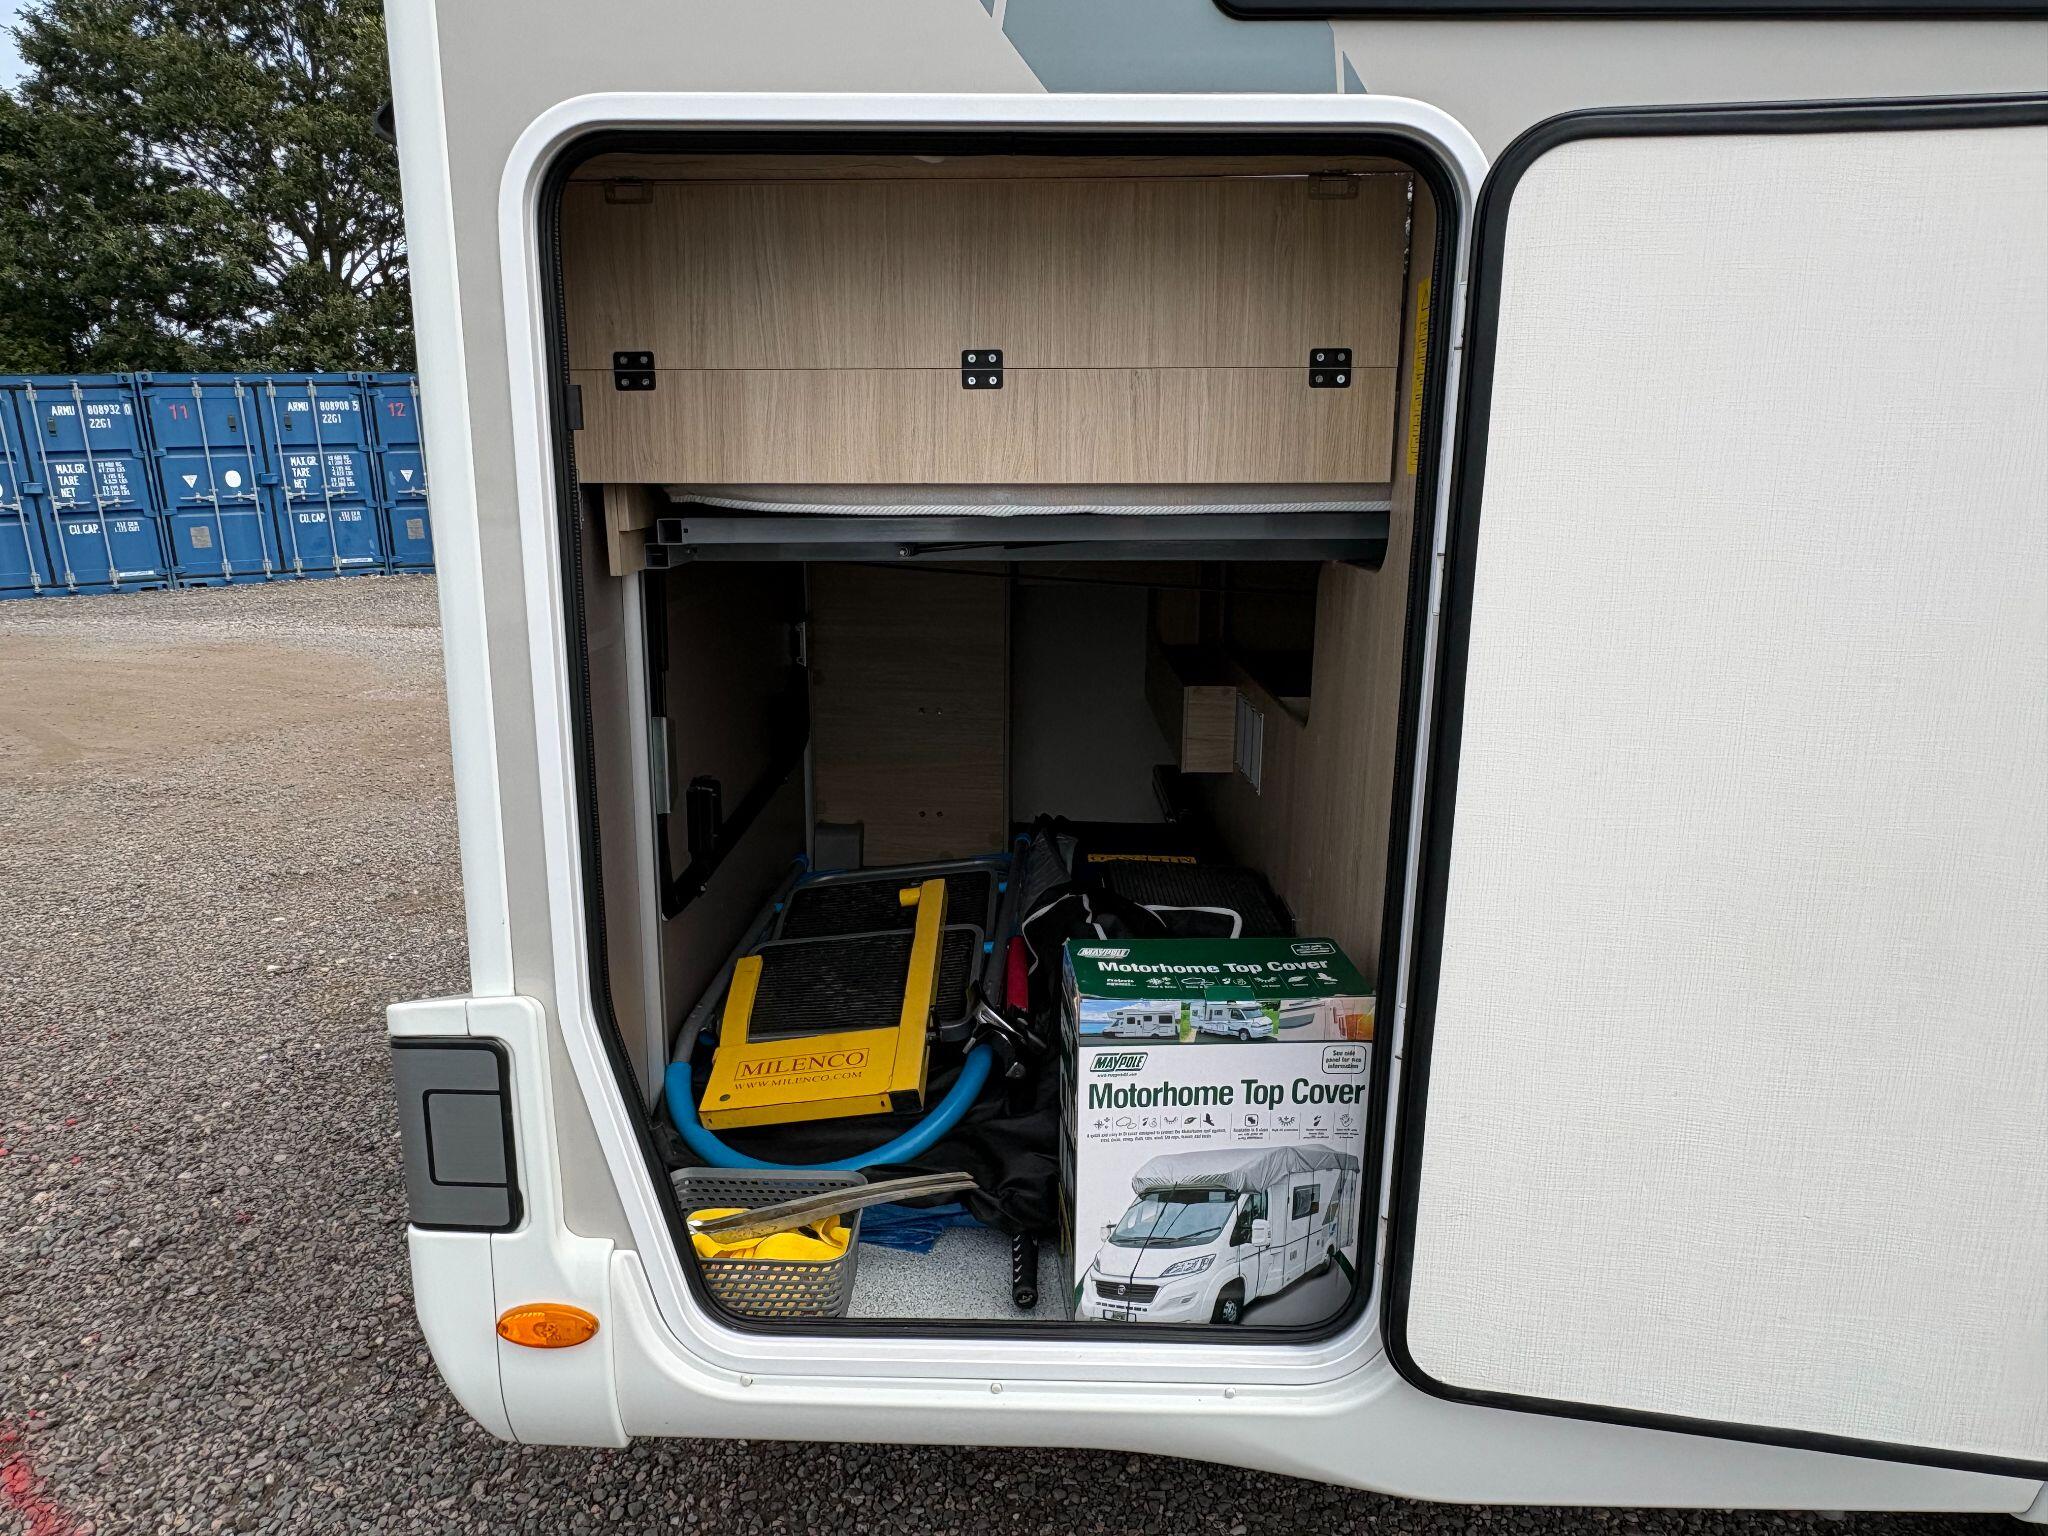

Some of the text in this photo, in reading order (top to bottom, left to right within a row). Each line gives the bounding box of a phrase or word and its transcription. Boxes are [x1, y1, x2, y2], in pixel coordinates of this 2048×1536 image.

[168, 403, 188, 420] 11
[387, 402, 406, 417] 12
[60, 487, 76, 498] NET
[1097, 960, 1328, 974] Motorhome Top Cover
[741, 1051, 865, 1078] MILENCO
[1094, 1055, 1144, 1069] MAYPOLE
[734, 1071, 863, 1090] WWW.MILENCO.COM
[1088, 1078, 1366, 1110] Motorhome Top Cover
